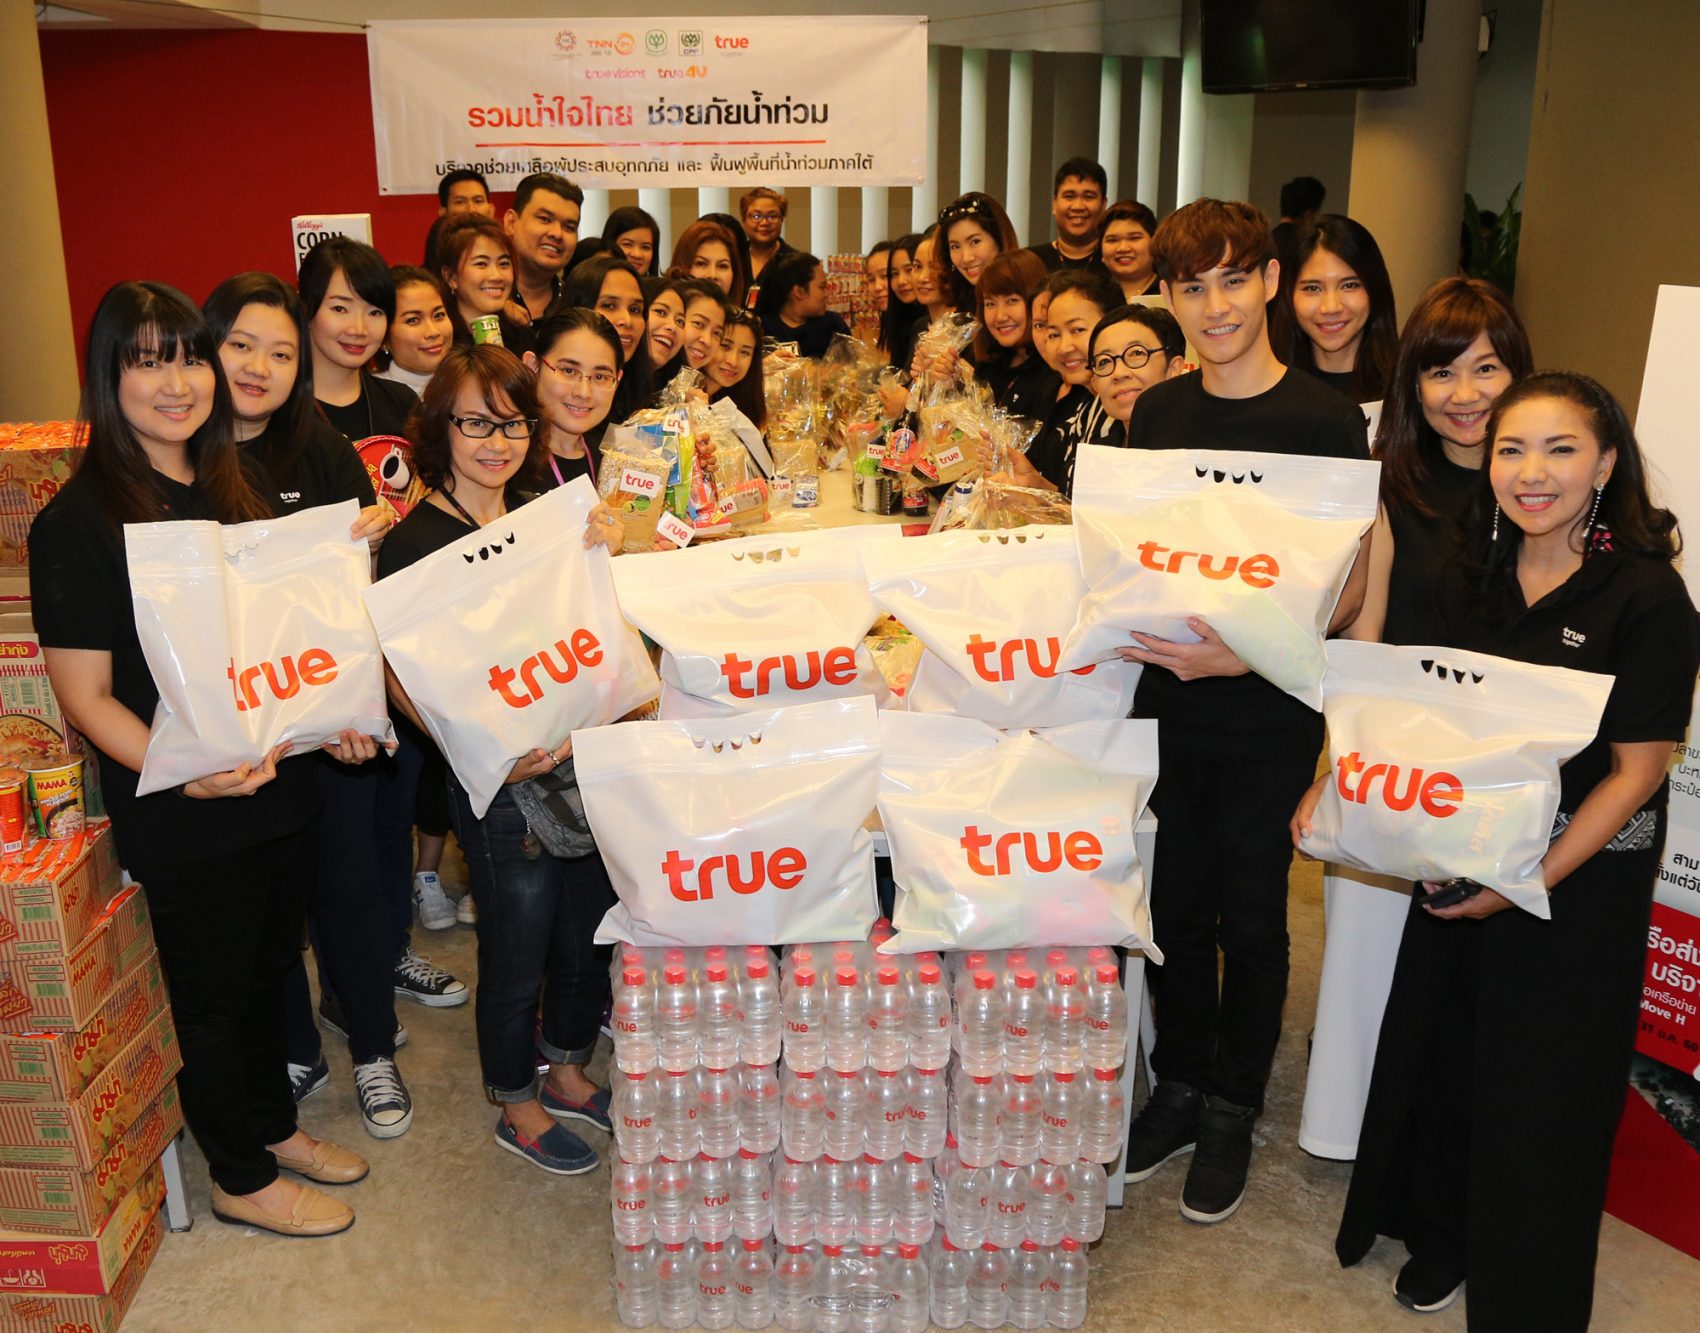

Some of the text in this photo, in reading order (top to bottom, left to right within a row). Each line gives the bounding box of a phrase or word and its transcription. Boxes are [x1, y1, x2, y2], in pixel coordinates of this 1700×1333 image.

[586, 39, 613, 48] TNN
[714, 34, 749, 49] true
[468, 90, 828, 127] รวมน้ำใจไทย ช่วยภัยน้ำท่วม
[677, 160, 702, 172] และ
[939, 452, 960, 465] true
[625, 473, 655, 490] true
[1136, 540, 1280, 589] true
[1563, 626, 1585, 643] true
[966, 634, 1097, 683] tru
[488, 627, 604, 709] true
[720, 646, 858, 699] true
[227, 648, 339, 712] true
[37, 779, 68, 790] MAMA
[1336, 752, 1464, 818] true
[960, 825, 1103, 876] true
[661, 846, 808, 902] true
[72, 955, 97, 987] MAMA
[616, 1019, 637, 1032] rue
[624, 1115, 652, 1129] true
[617, 1199, 646, 1211] true
[704, 1193, 730, 1208] true
[998, 1201, 1026, 1214] true
[700, 1283, 727, 1296] true
